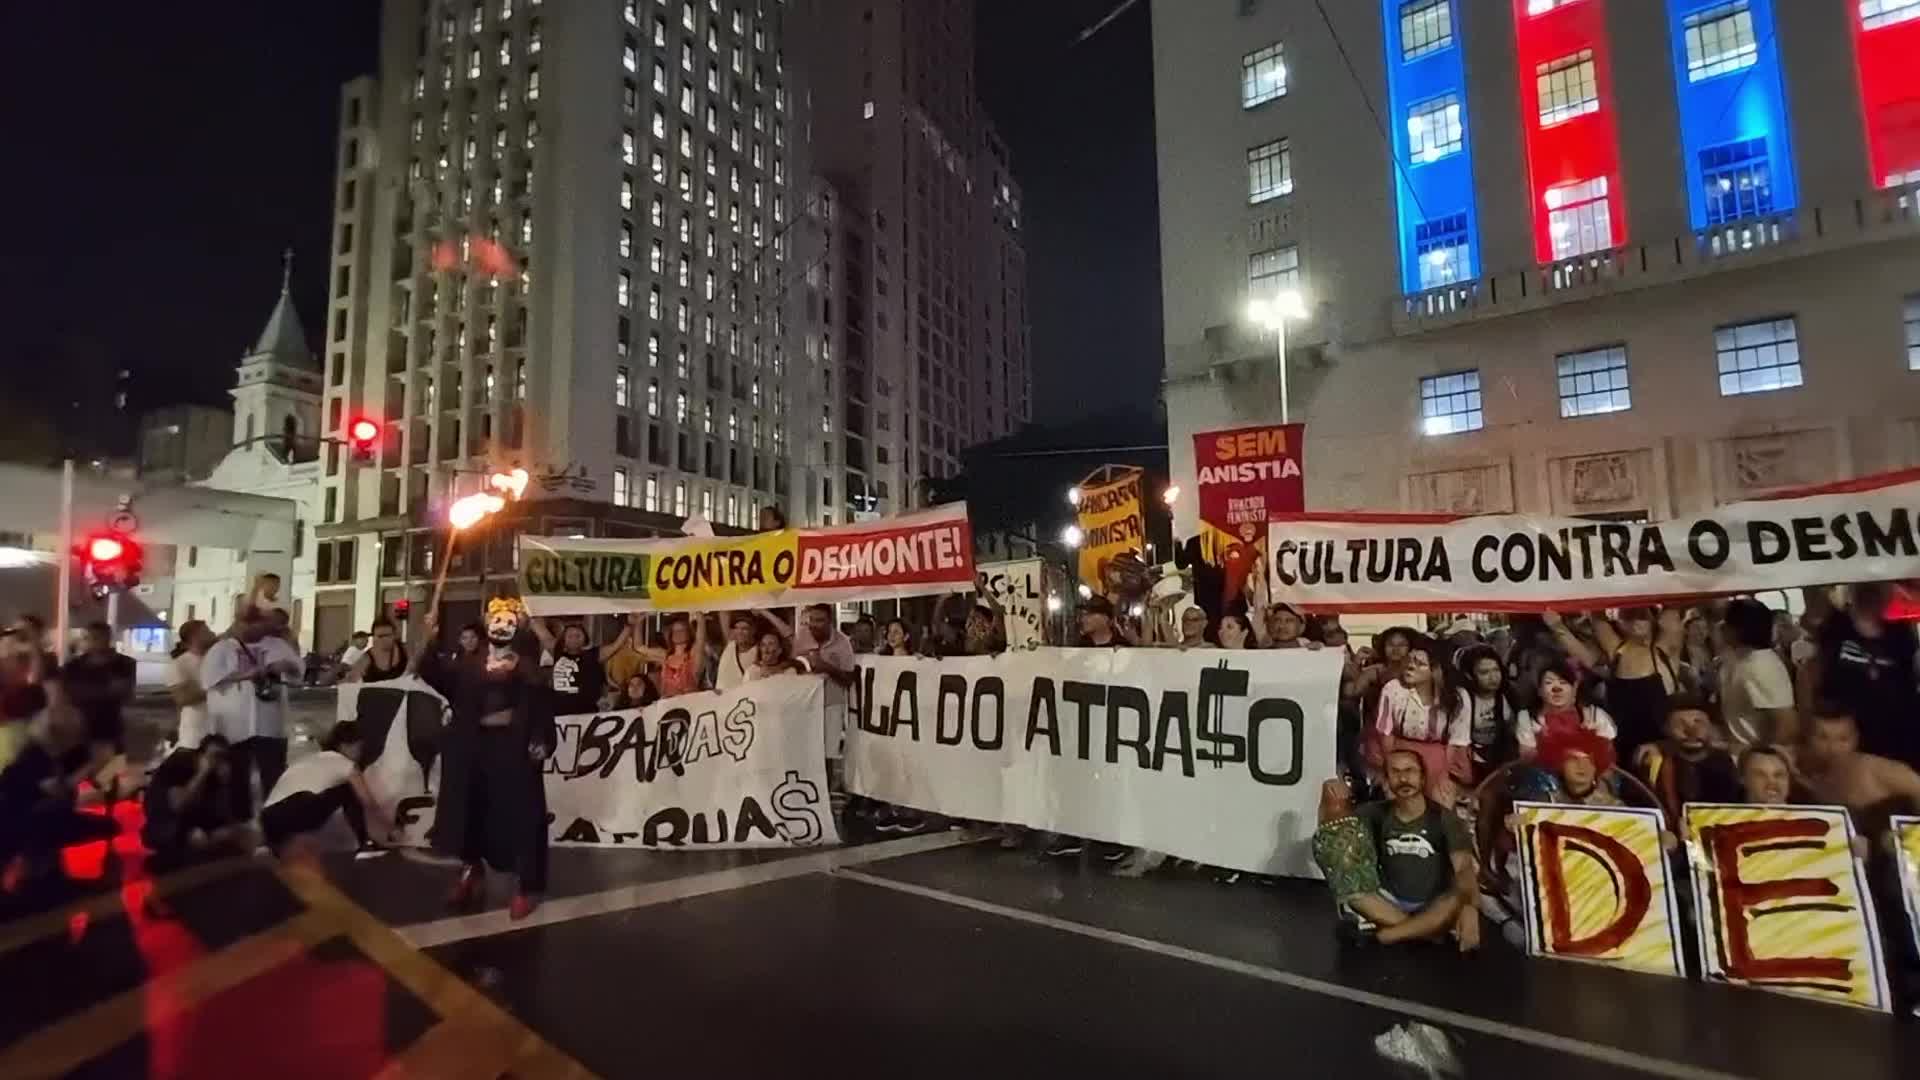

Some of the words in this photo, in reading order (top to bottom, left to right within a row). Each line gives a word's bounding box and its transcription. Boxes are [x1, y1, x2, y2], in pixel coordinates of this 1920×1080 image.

[1198, 458, 1301, 485] ANISTIA
[1215, 429, 1287, 461] SEM
[525, 552, 646, 594] CULTURA
[655, 549, 765, 590] CONTRA
[773, 548, 794, 585] O
[800, 526, 965, 585] DESMONTE!
[1275, 535, 1452, 586] CULTURA
[1471, 524, 1675, 584] CONTRA
[1687, 518, 1731, 571] O
[1746, 507, 1920, 565] DESM
[935, 673, 1005, 751] DO
[1527, 818, 1652, 957] D
[1706, 816, 1853, 990] E
